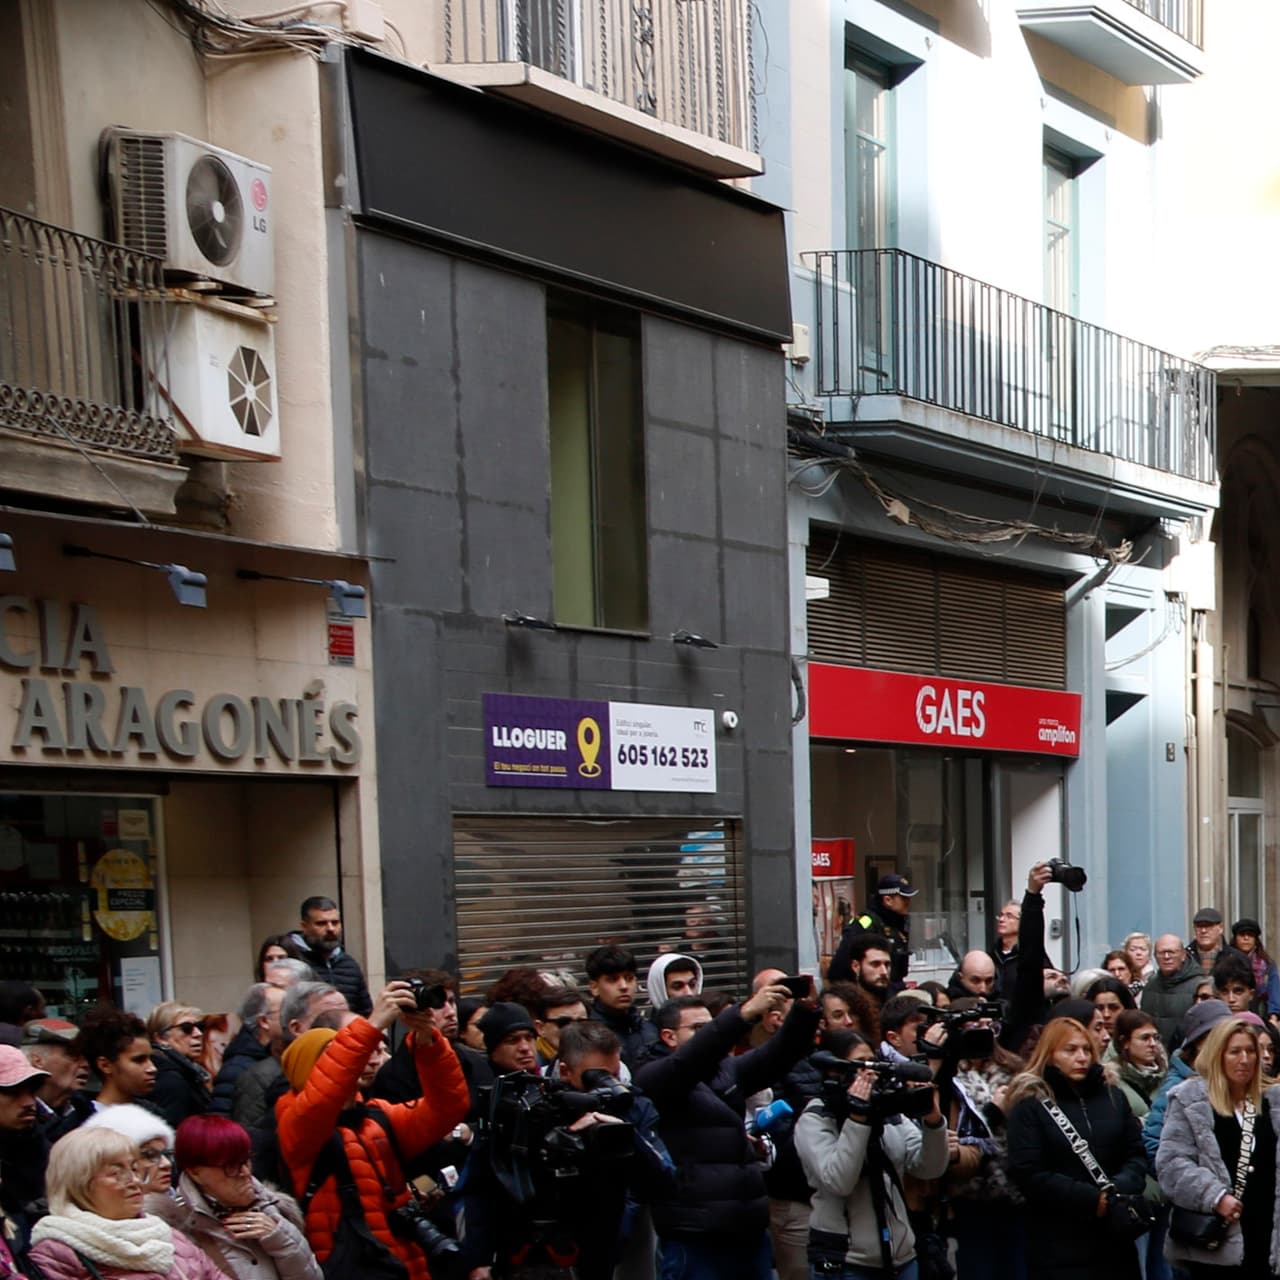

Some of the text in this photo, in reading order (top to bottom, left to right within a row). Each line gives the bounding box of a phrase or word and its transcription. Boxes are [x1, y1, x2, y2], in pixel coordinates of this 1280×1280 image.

[253, 216, 267, 233] LG
[12, 678, 363, 767] ARAGONÉS
[915, 685, 986, 738] GAES
[492, 725, 567, 751] LLOGUER
[1038, 724, 1076, 747] amplifon
[617, 744, 709, 769] 605 162 523
